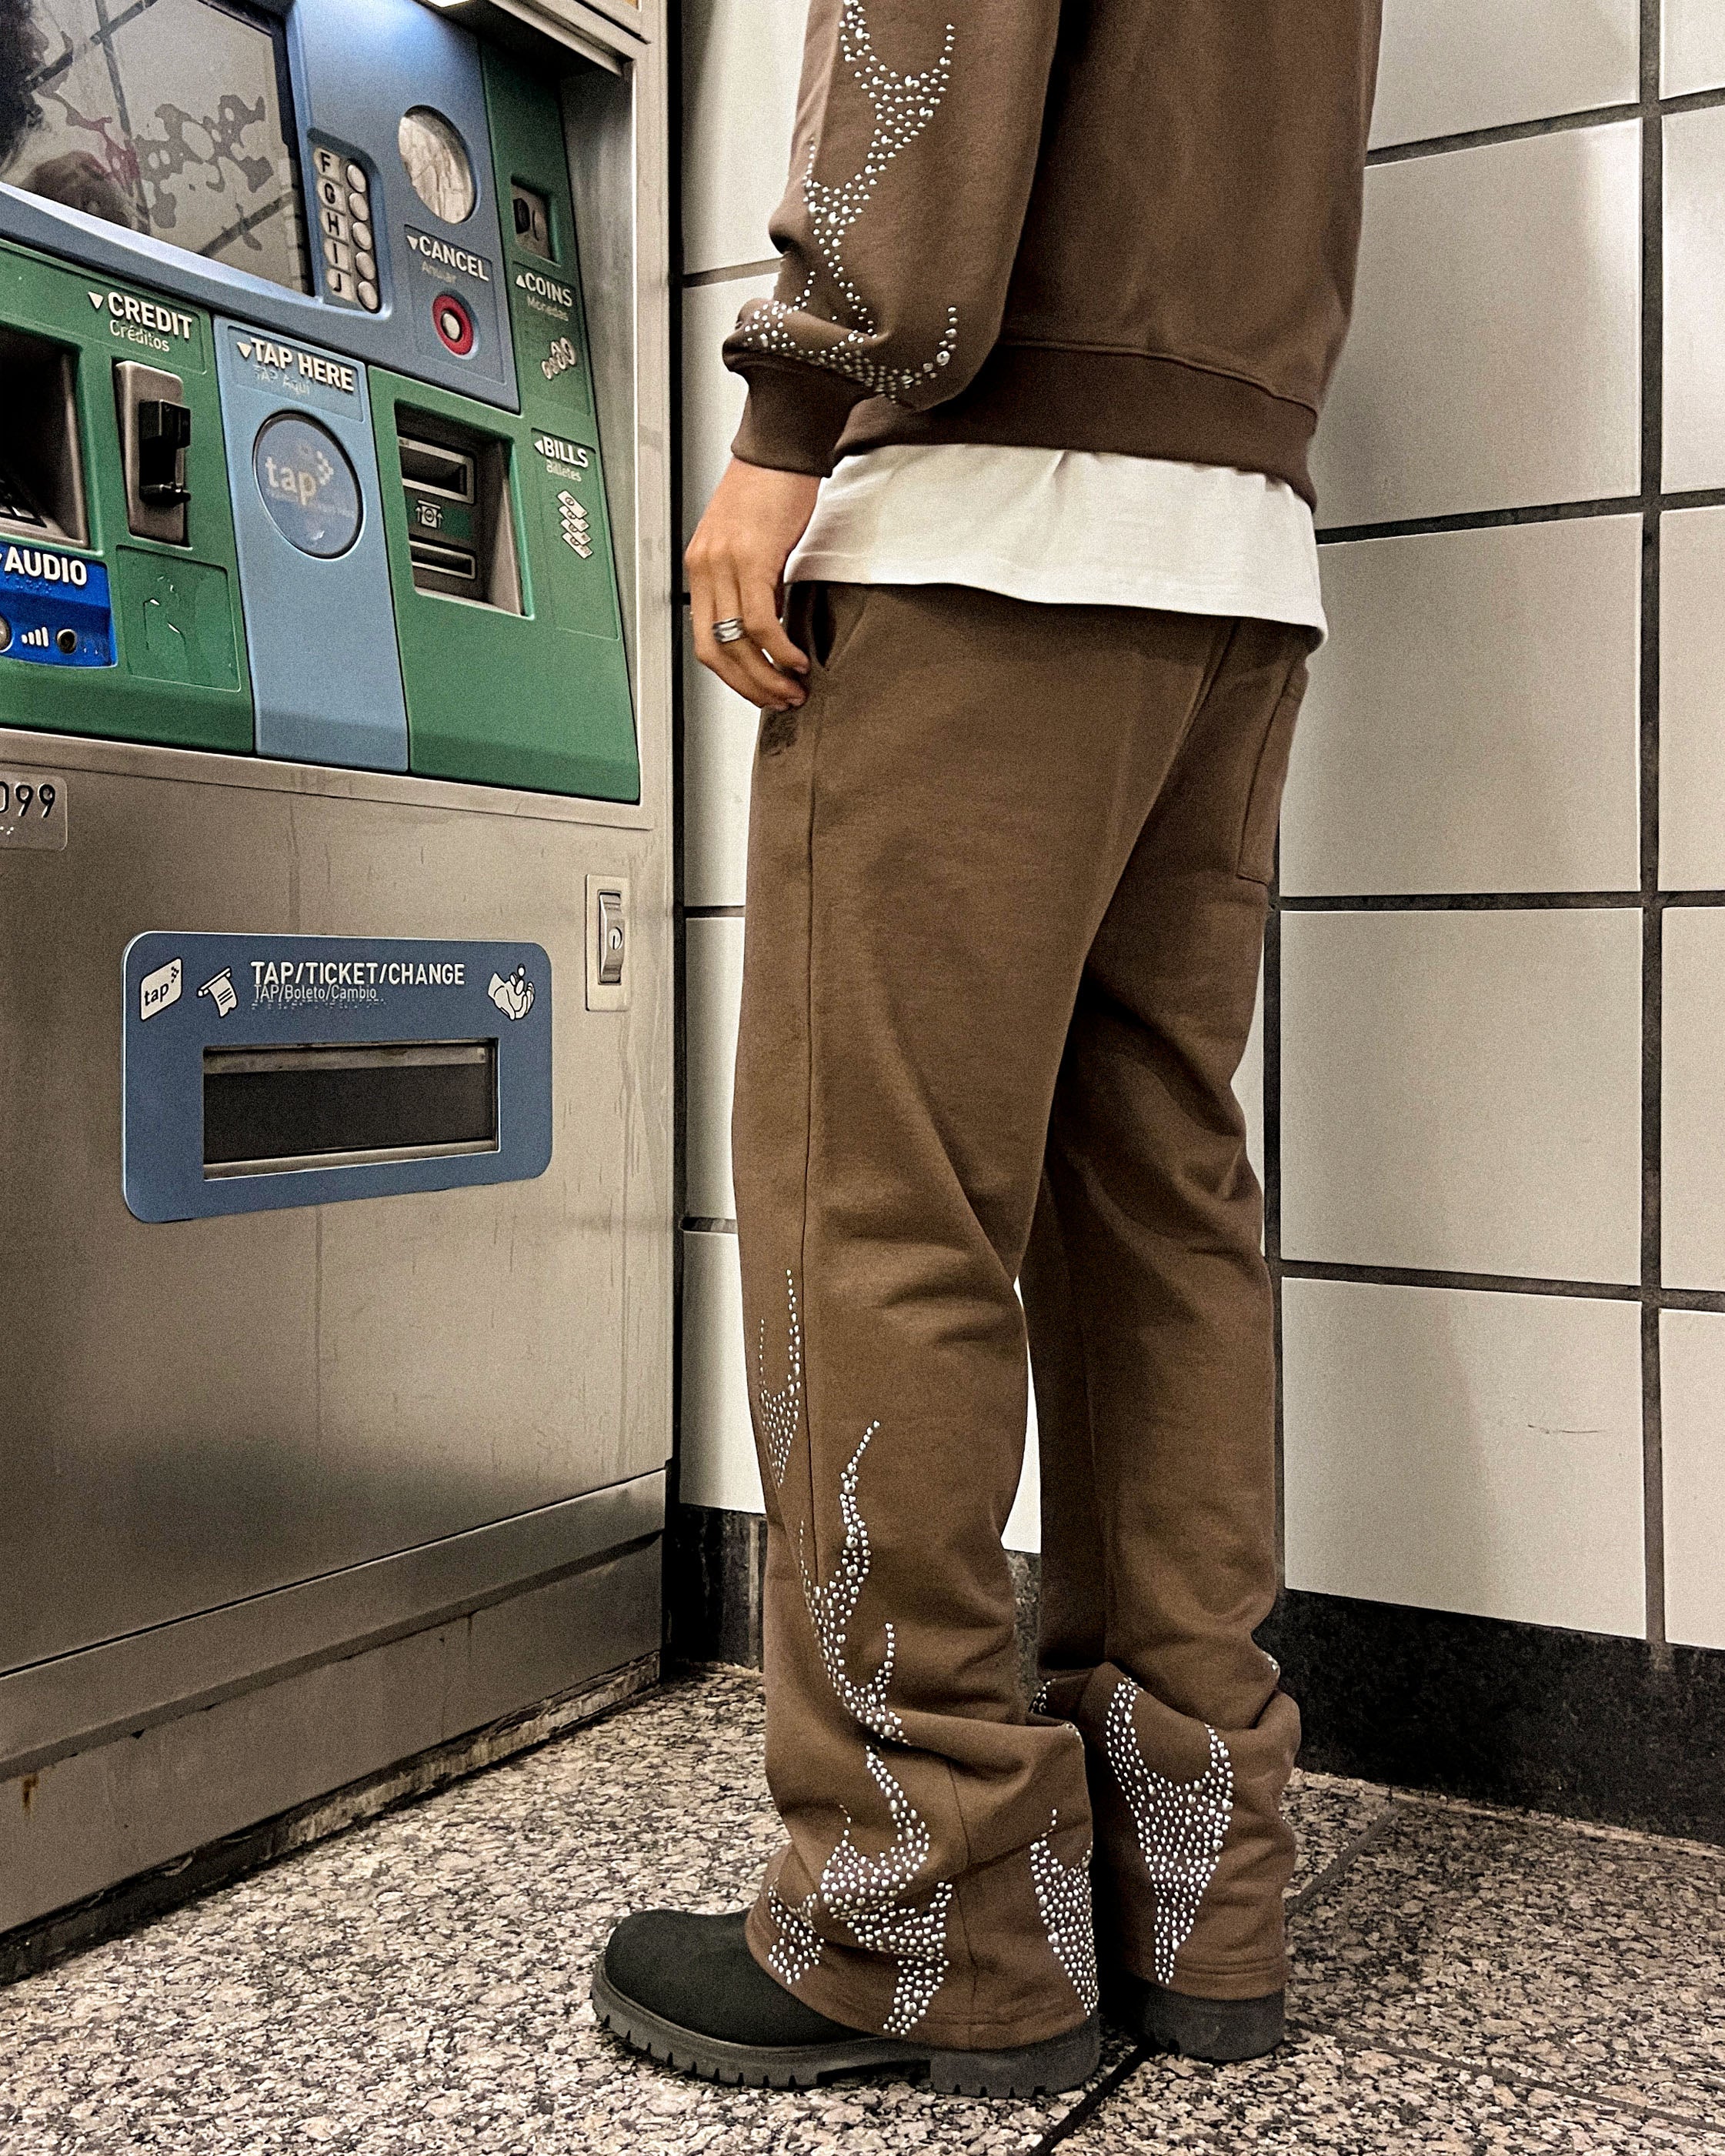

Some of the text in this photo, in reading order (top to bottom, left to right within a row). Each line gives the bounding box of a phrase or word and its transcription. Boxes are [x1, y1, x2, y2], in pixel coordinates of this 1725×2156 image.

[320, 152, 331, 172] F
[324, 182, 336, 204] G
[327, 212, 340, 236] H
[333, 242, 339, 264] I
[419, 235, 489, 282] CANCEL
[333, 273, 342, 292] J
[525, 272, 572, 307] COINS
[108, 292, 192, 339] CREDIT
[109, 319, 170, 352] Créditos
[250, 337, 355, 392] TAP HERE
[542, 436, 589, 469] BILLS
[265, 456, 317, 506] tap
[4, 546, 88, 586] AUDIO
[250, 961, 465, 986] TAP/TICKET/CHANGE
[144, 983, 169, 1006] tap
[254, 984, 377, 1000] TAP/Boleto/Cambio
